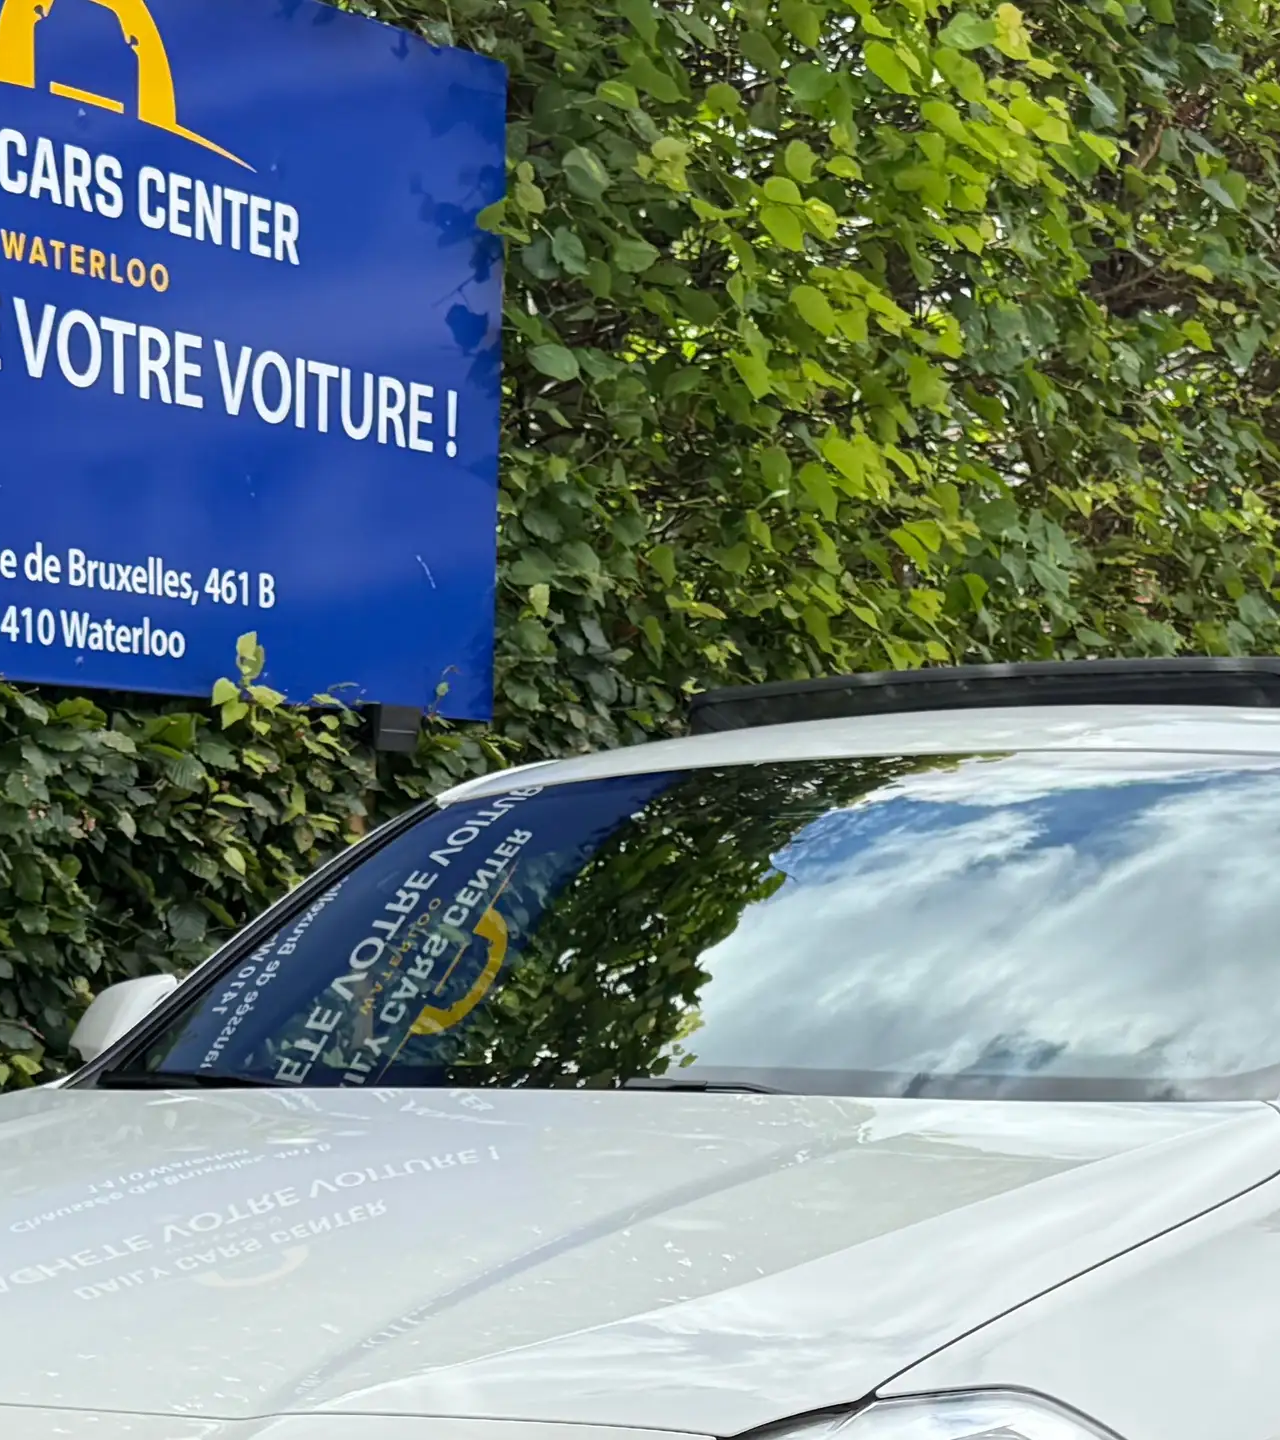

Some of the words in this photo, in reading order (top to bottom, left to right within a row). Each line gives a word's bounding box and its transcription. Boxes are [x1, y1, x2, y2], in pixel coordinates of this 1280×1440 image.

[139, 167, 299, 265] CENTER
[1, 228, 170, 292] WATERLOO
[14, 297, 203, 408] VOTRE
[214, 340, 433, 452] VOITURE
[25, 542, 61, 583] de
[69, 549, 198, 605] Bruxelles,
[205, 568, 248, 605] 461
[259, 573, 274, 608] B
[61, 610, 185, 657] Waterloo
